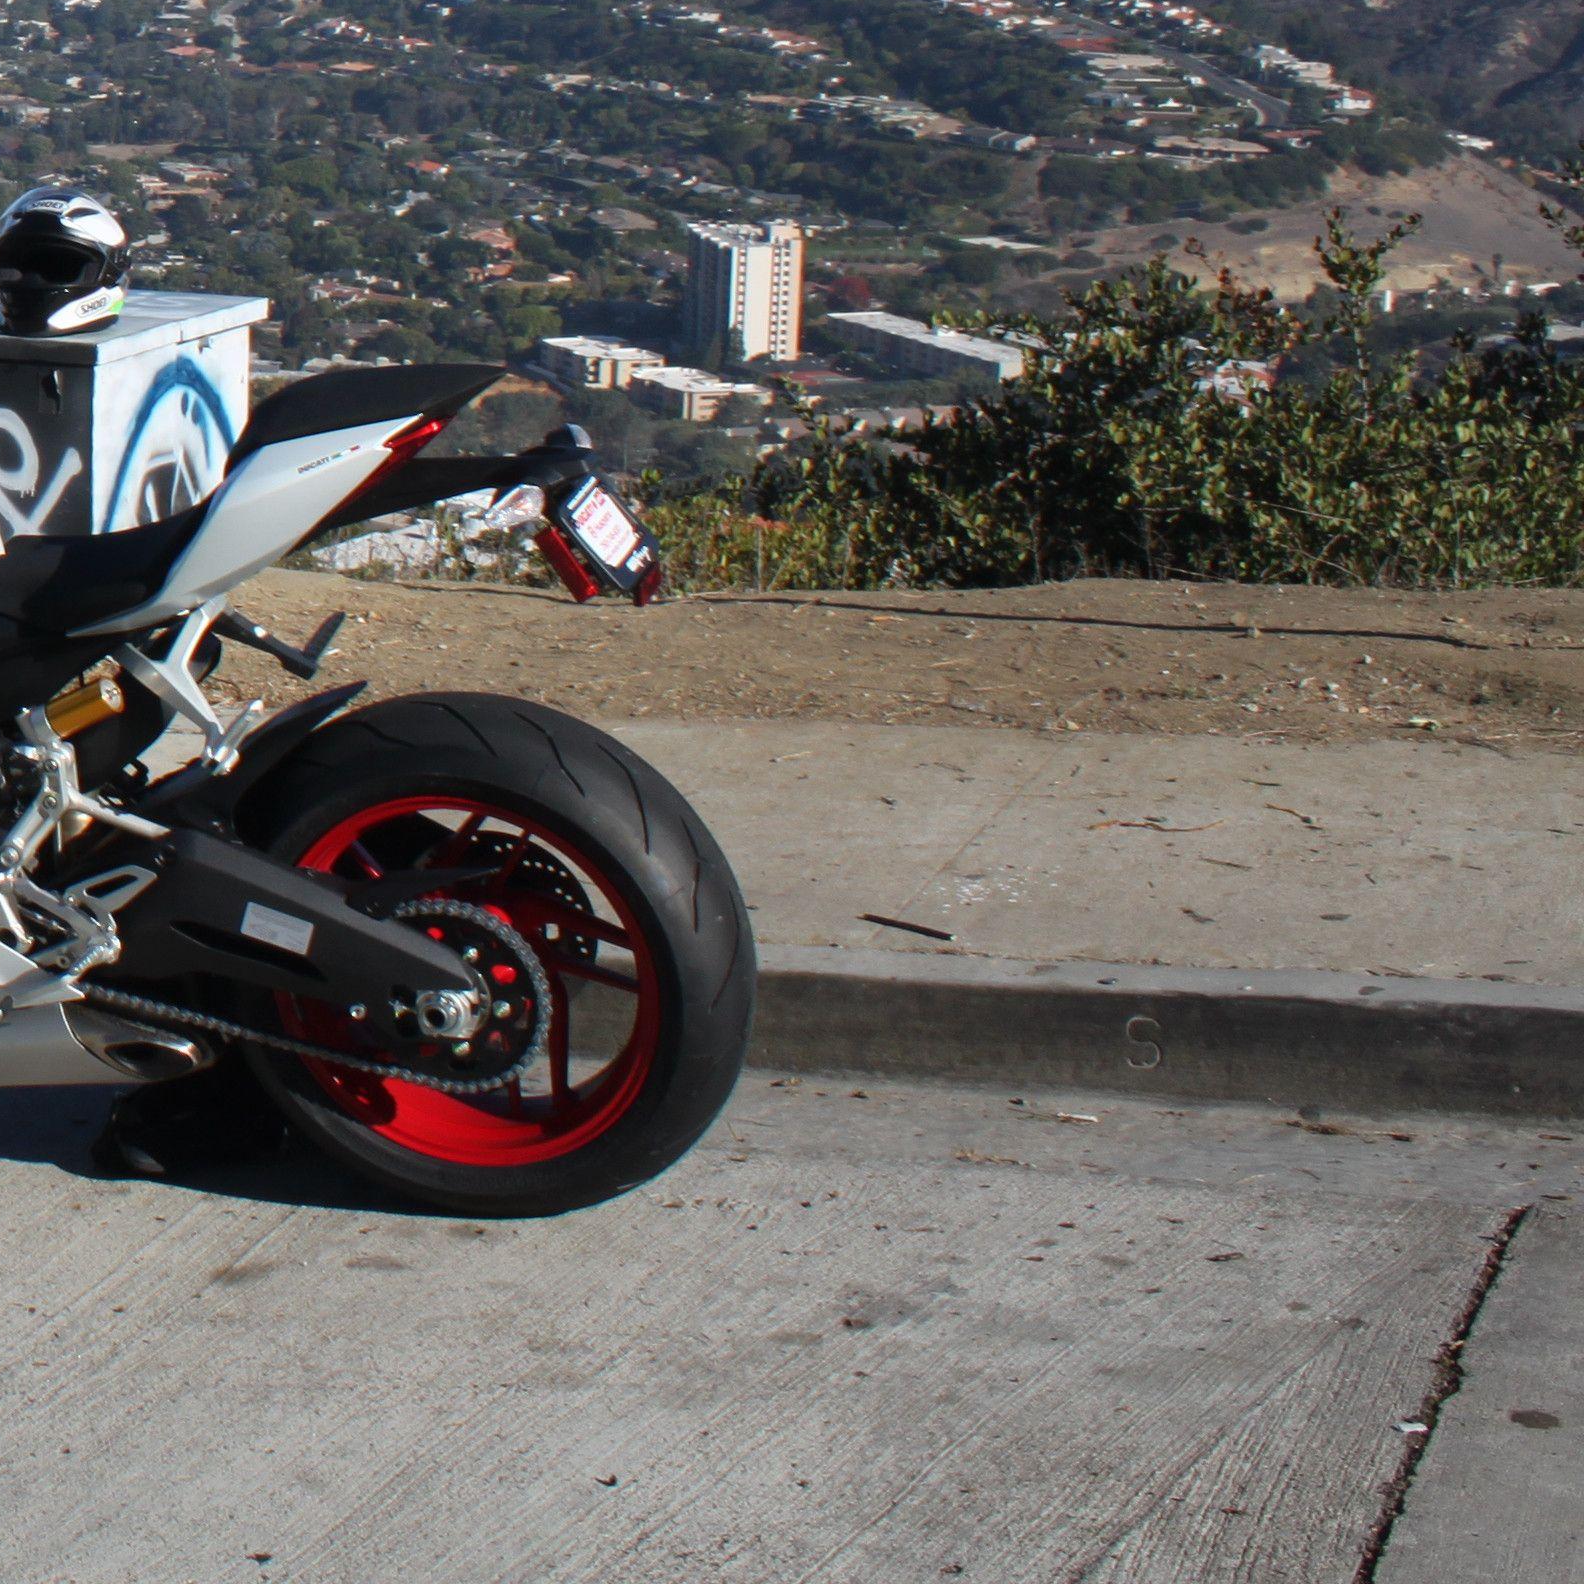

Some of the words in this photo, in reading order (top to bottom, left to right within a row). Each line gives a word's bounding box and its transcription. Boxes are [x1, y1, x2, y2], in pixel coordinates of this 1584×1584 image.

[80, 296, 108, 315] SHOEI
[297, 456, 330, 474] DUCATI
[1125, 1015, 1164, 1070] S
